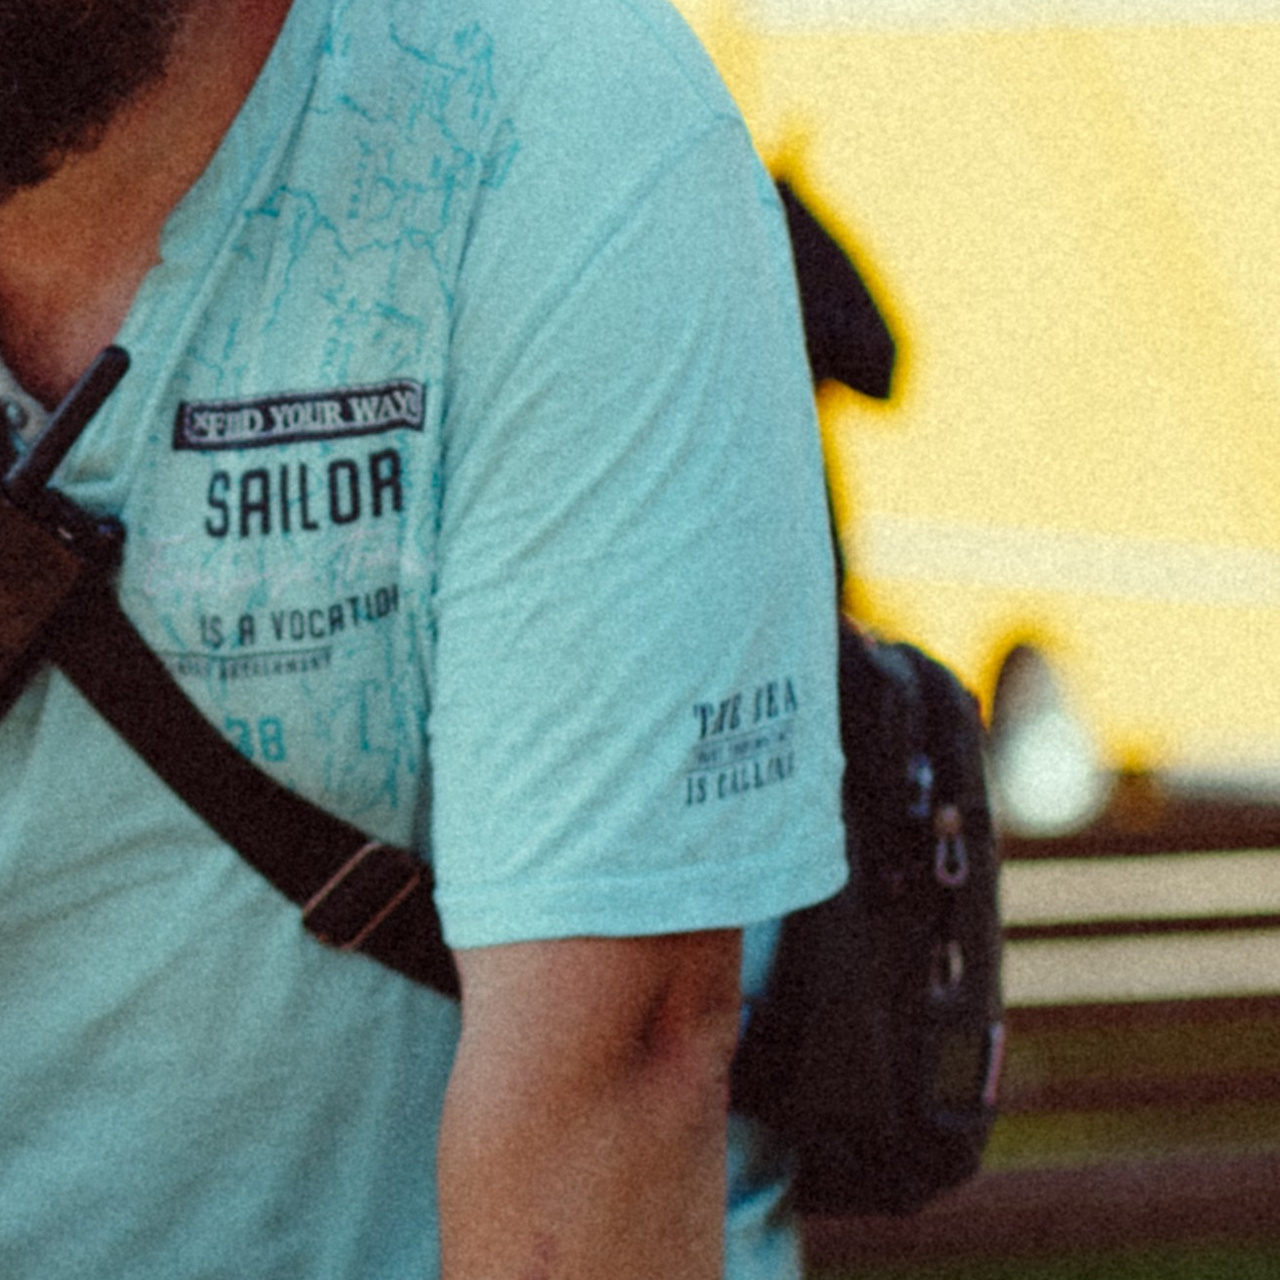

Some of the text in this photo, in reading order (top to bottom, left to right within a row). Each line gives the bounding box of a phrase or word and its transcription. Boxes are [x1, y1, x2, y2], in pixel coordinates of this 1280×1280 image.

[269, 401, 345, 433] YOUR
[347, 391, 413, 424] WAY
[206, 447, 403, 539] SAILOR
[200, 614, 224, 650] IS
[237, 614, 256, 647] A
[686, 775, 707, 807] IS
